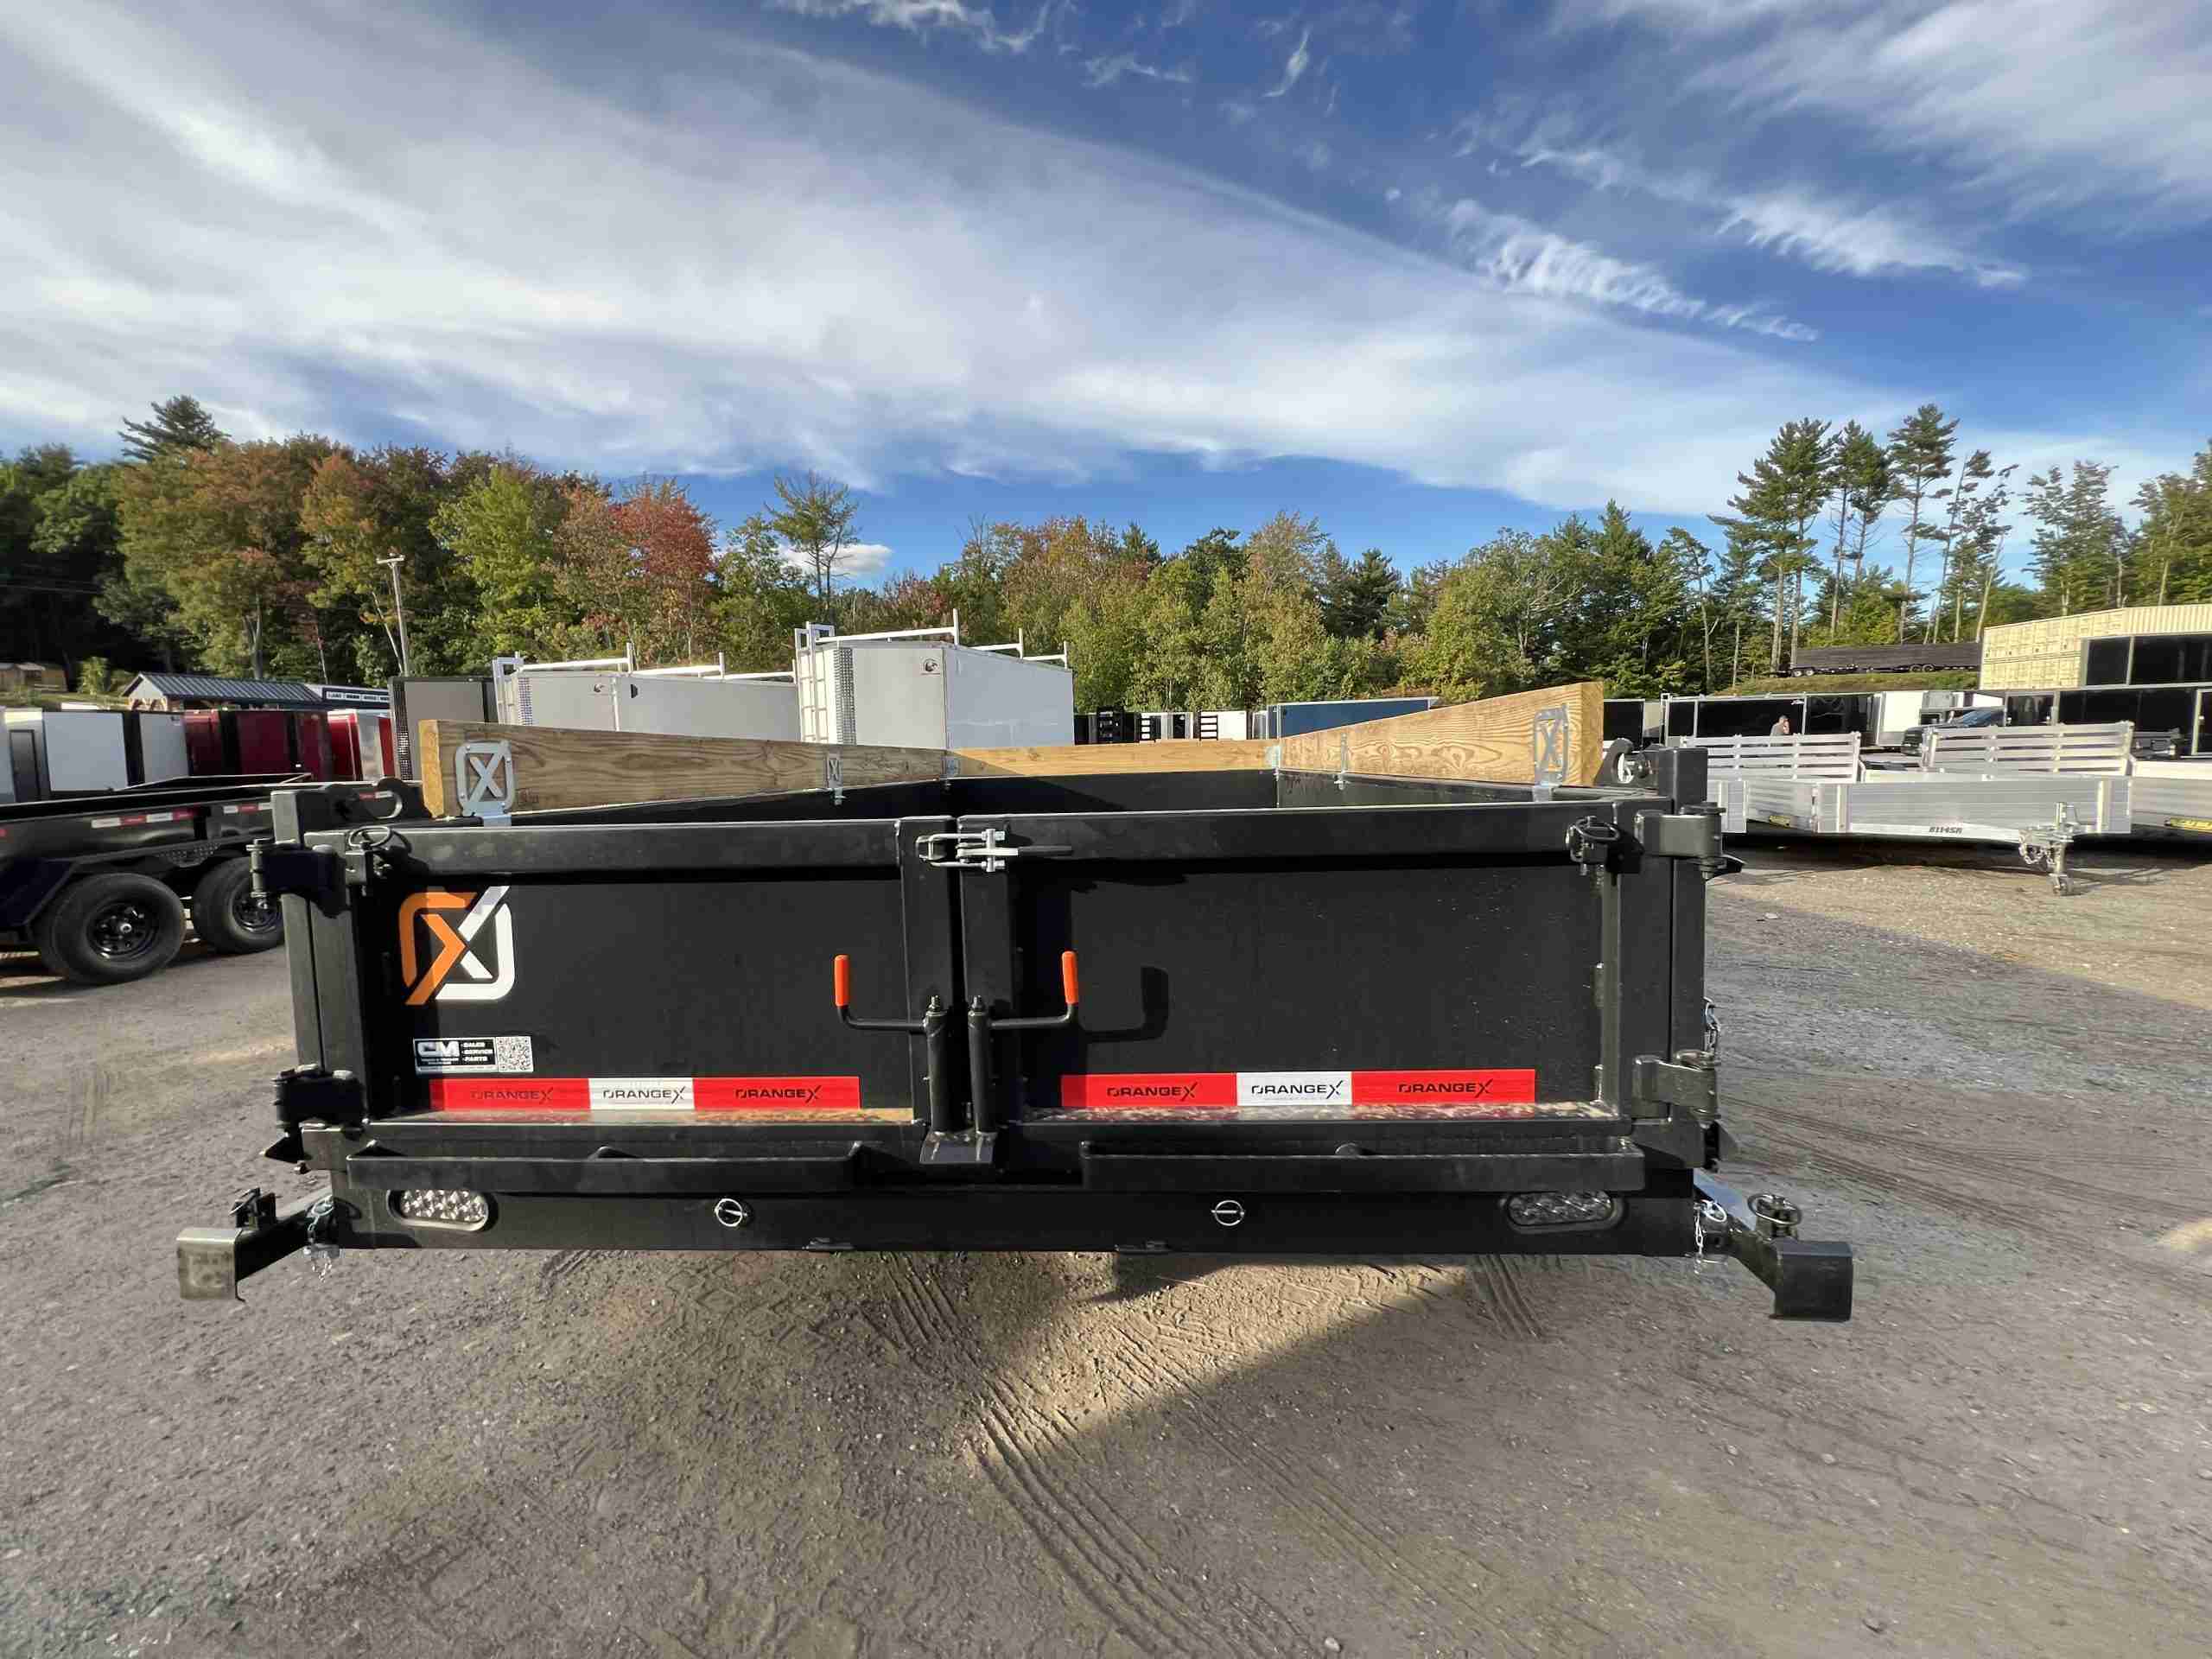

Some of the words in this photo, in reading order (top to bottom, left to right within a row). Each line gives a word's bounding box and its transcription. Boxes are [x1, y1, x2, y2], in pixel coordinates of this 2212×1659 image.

[602, 1085, 686, 1104] ORANGEX
[734, 1084, 823, 1103] ORANGEX
[1106, 1081, 1198, 1102] ORANGEX
[1251, 1079, 1344, 1099] ORANGEX
[1398, 1077, 1494, 1098] ORANGEX
